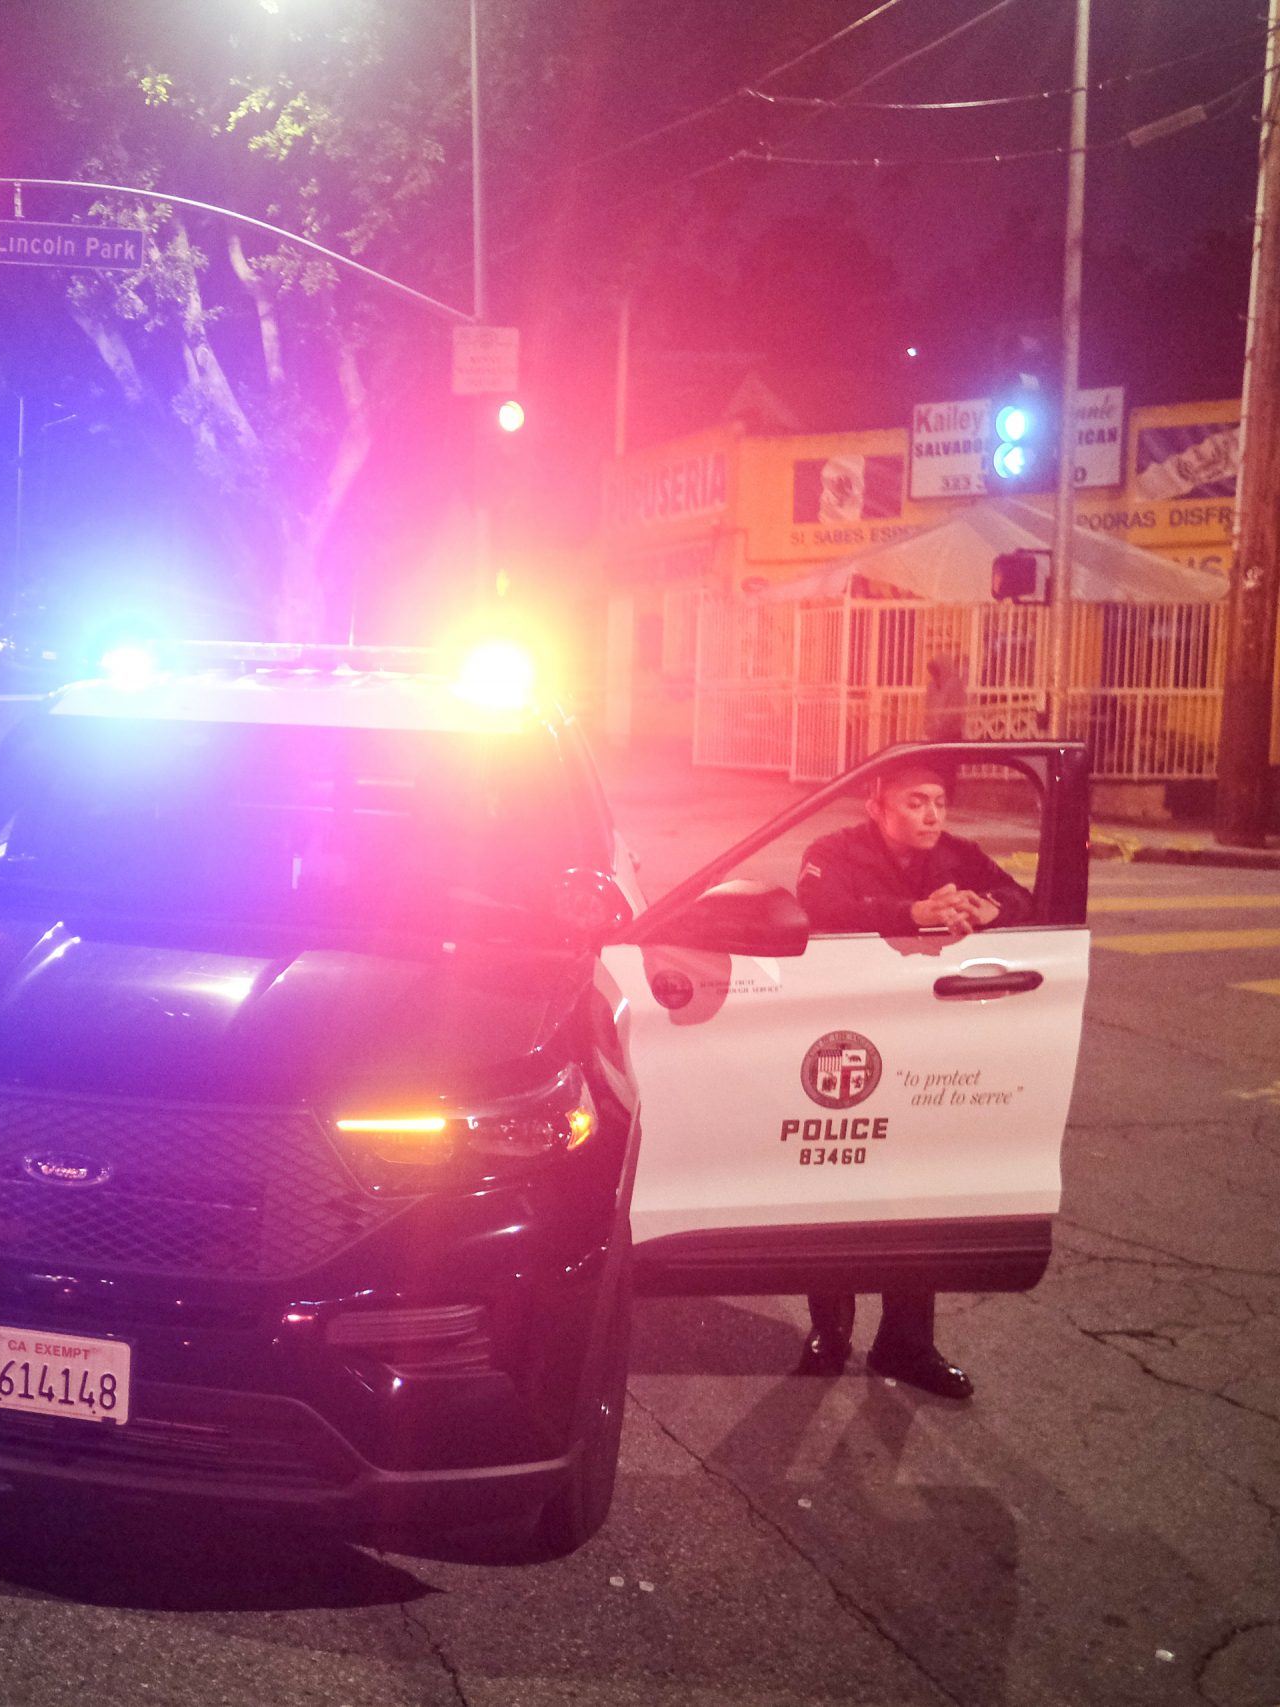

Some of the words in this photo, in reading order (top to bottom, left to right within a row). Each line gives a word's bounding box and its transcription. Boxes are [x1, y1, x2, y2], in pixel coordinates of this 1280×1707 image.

[85, 236, 136, 261] Park
[914, 437, 984, 458] SALVADO
[1077, 426, 1118, 447] ICAN
[1075, 509, 1157, 531] PODRAS
[813, 527, 865, 545] SABES
[923, 1069, 981, 1091] protect
[910, 1087, 946, 1106] and
[949, 1090, 966, 1106] to
[780, 1117, 889, 1142] POLICE
[799, 1146, 867, 1166] 83460
[7, 1339, 27, 1352] CA
[34, 1341, 91, 1361] EXEMPT
